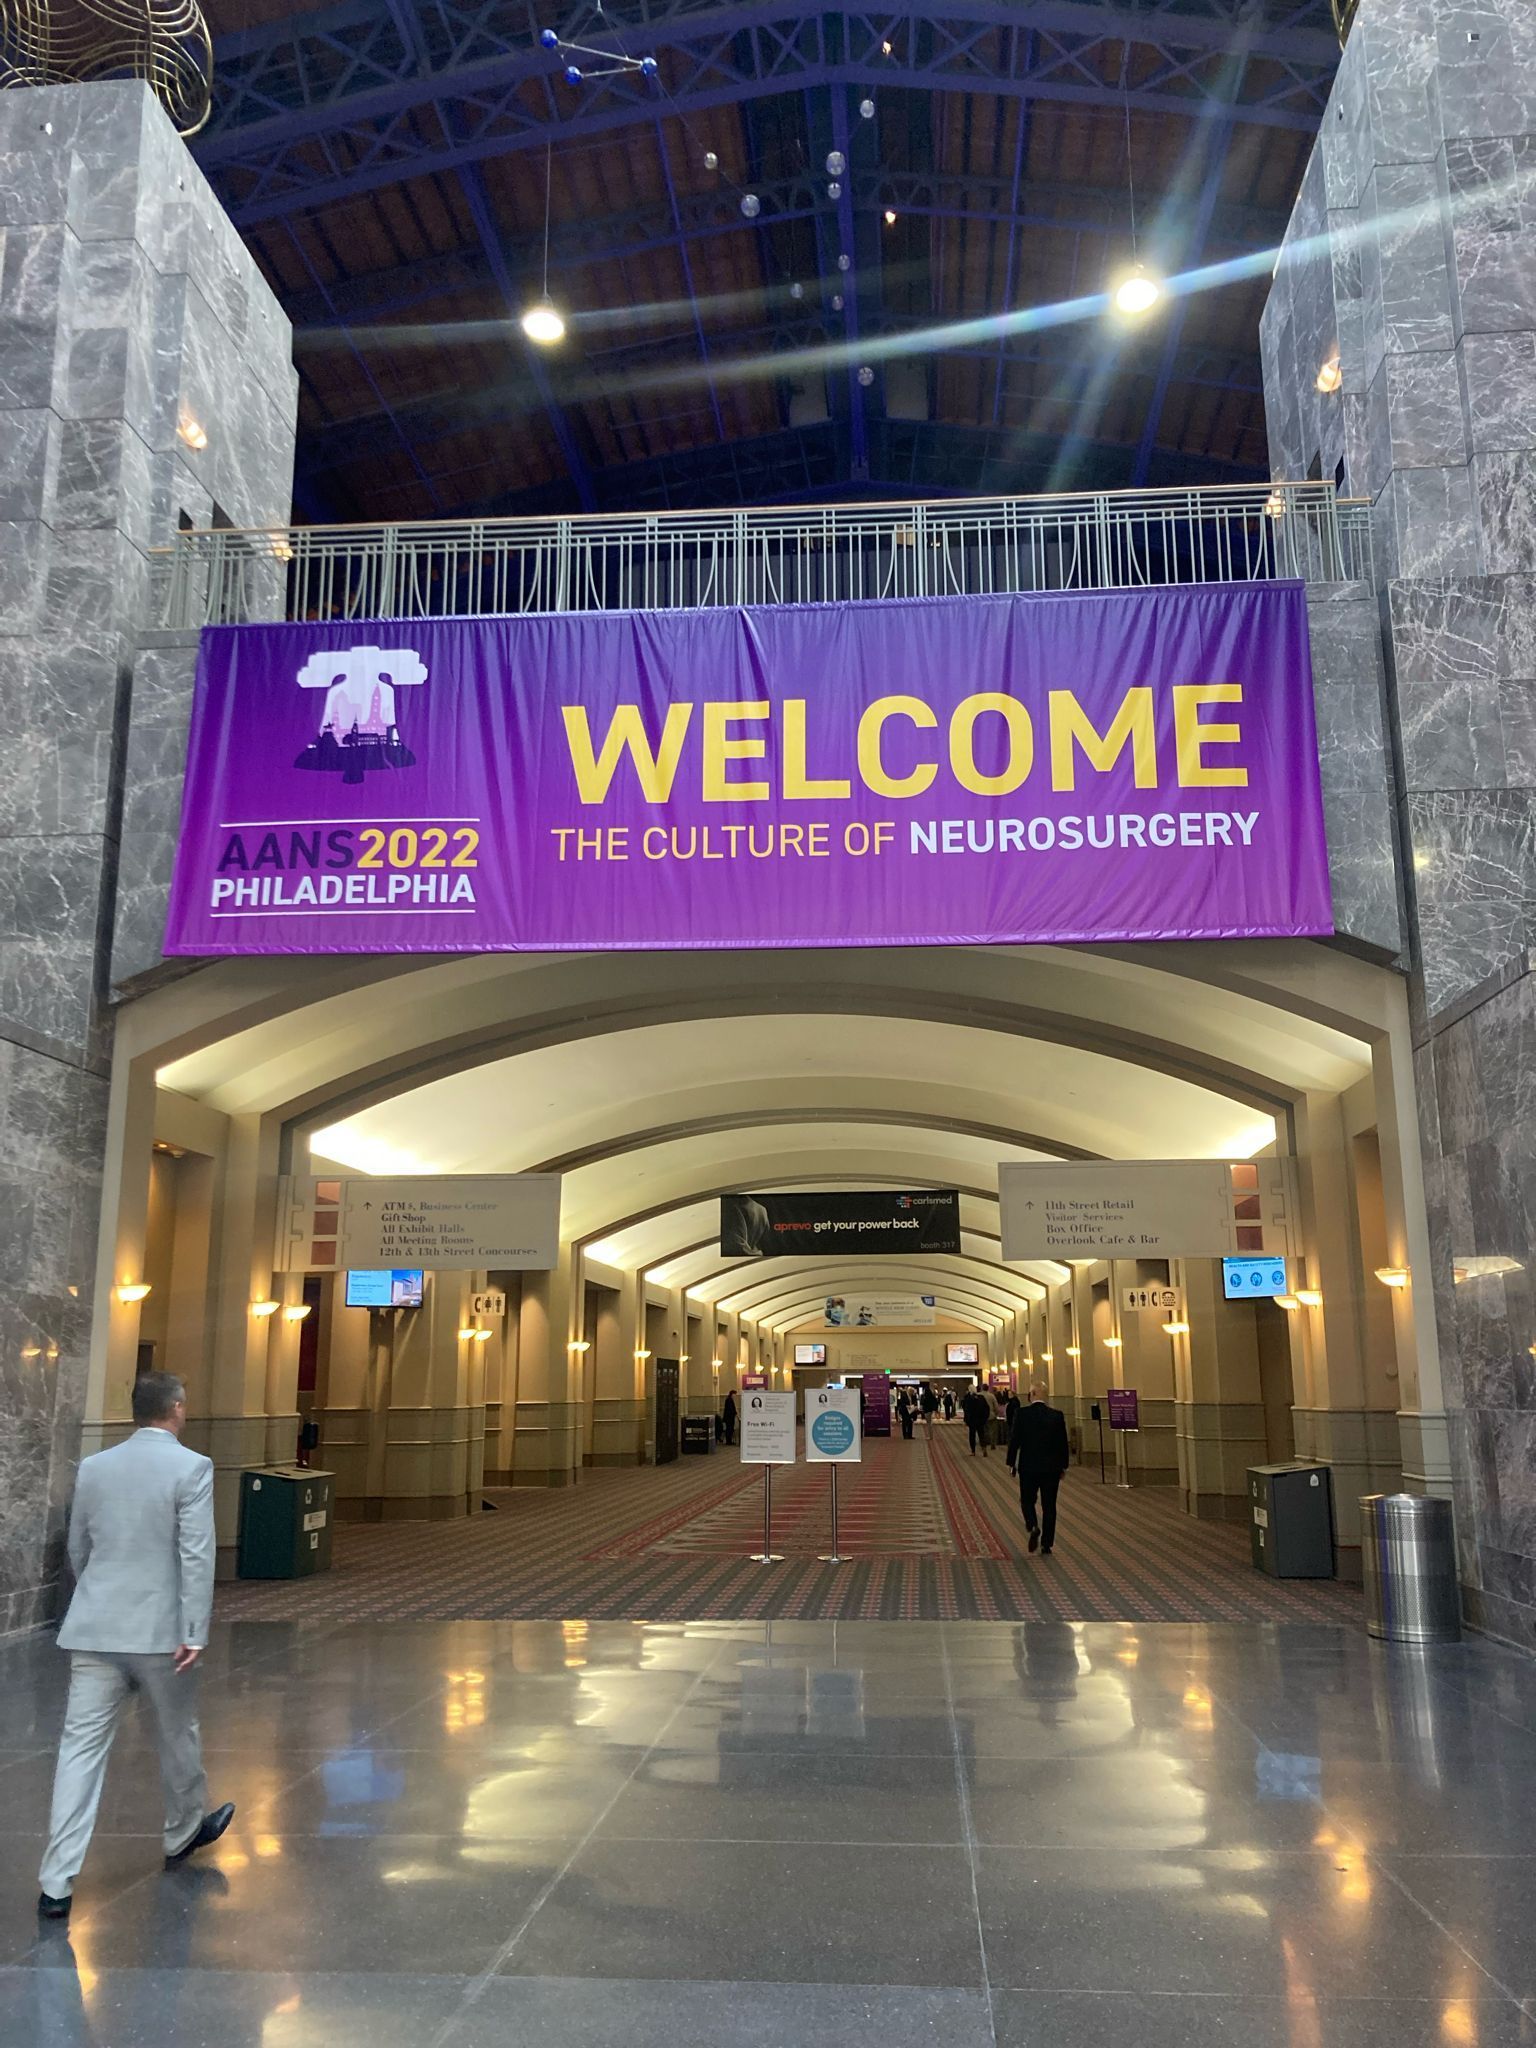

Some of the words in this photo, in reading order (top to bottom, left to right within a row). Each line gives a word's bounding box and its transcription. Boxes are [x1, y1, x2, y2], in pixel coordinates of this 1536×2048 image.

[561, 683, 1249, 805] WELCOME
[551, 827, 629, 861] THE
[643, 824, 830, 860] CULTURE
[844, 822, 895, 856] OF
[910, 812, 1260, 854] NEUROSURGERY
[211, 873, 476, 909] PHILADELPHIA
[420, 1201, 462, 1211] Business
[465, 1200, 498, 1211] Center
[912, 1196, 952, 1205] carlsmed
[1045, 1200, 1066, 1210] 11th
[1069, 1200, 1100, 1210] Street
[1103, 1200, 1134, 1210] Retail
[381, 1213, 400, 1222] Gift
[402, 1213, 426, 1224] Shop
[1046, 1212, 1076, 1222] Visitor
[1083, 1212, 1124, 1222] Services
[380, 1224, 395, 1234] All
[398, 1224, 434, 1234] Exhibit
[439, 1224, 464, 1233] Halls
[774, 1221, 812, 1232] aprevo
[814, 1221, 831, 1232] get
[833, 1220, 856, 1232] your
[858, 1220, 891, 1232] power
[893, 1218, 920, 1229] back
[1046, 1224, 1065, 1234] Box
[1070, 1223, 1104, 1233] Office
[380, 1236, 394, 1245] All
[398, 1236, 437, 1246] Meeting
[441, 1236, 474, 1245] Rooms
[1047, 1236, 1096, 1246] Overlook
[1100, 1235, 1124, 1244] Cafe
[1128, 1236, 1136, 1244] &
[1140, 1235, 1160, 1244] Bar
[380, 1247, 402, 1256] 12th
[405, 1248, 414, 1256] &
[418, 1247, 440, 1256] 13th
[443, 1247, 474, 1256] Street
[478, 1246, 538, 1256] Concourses
